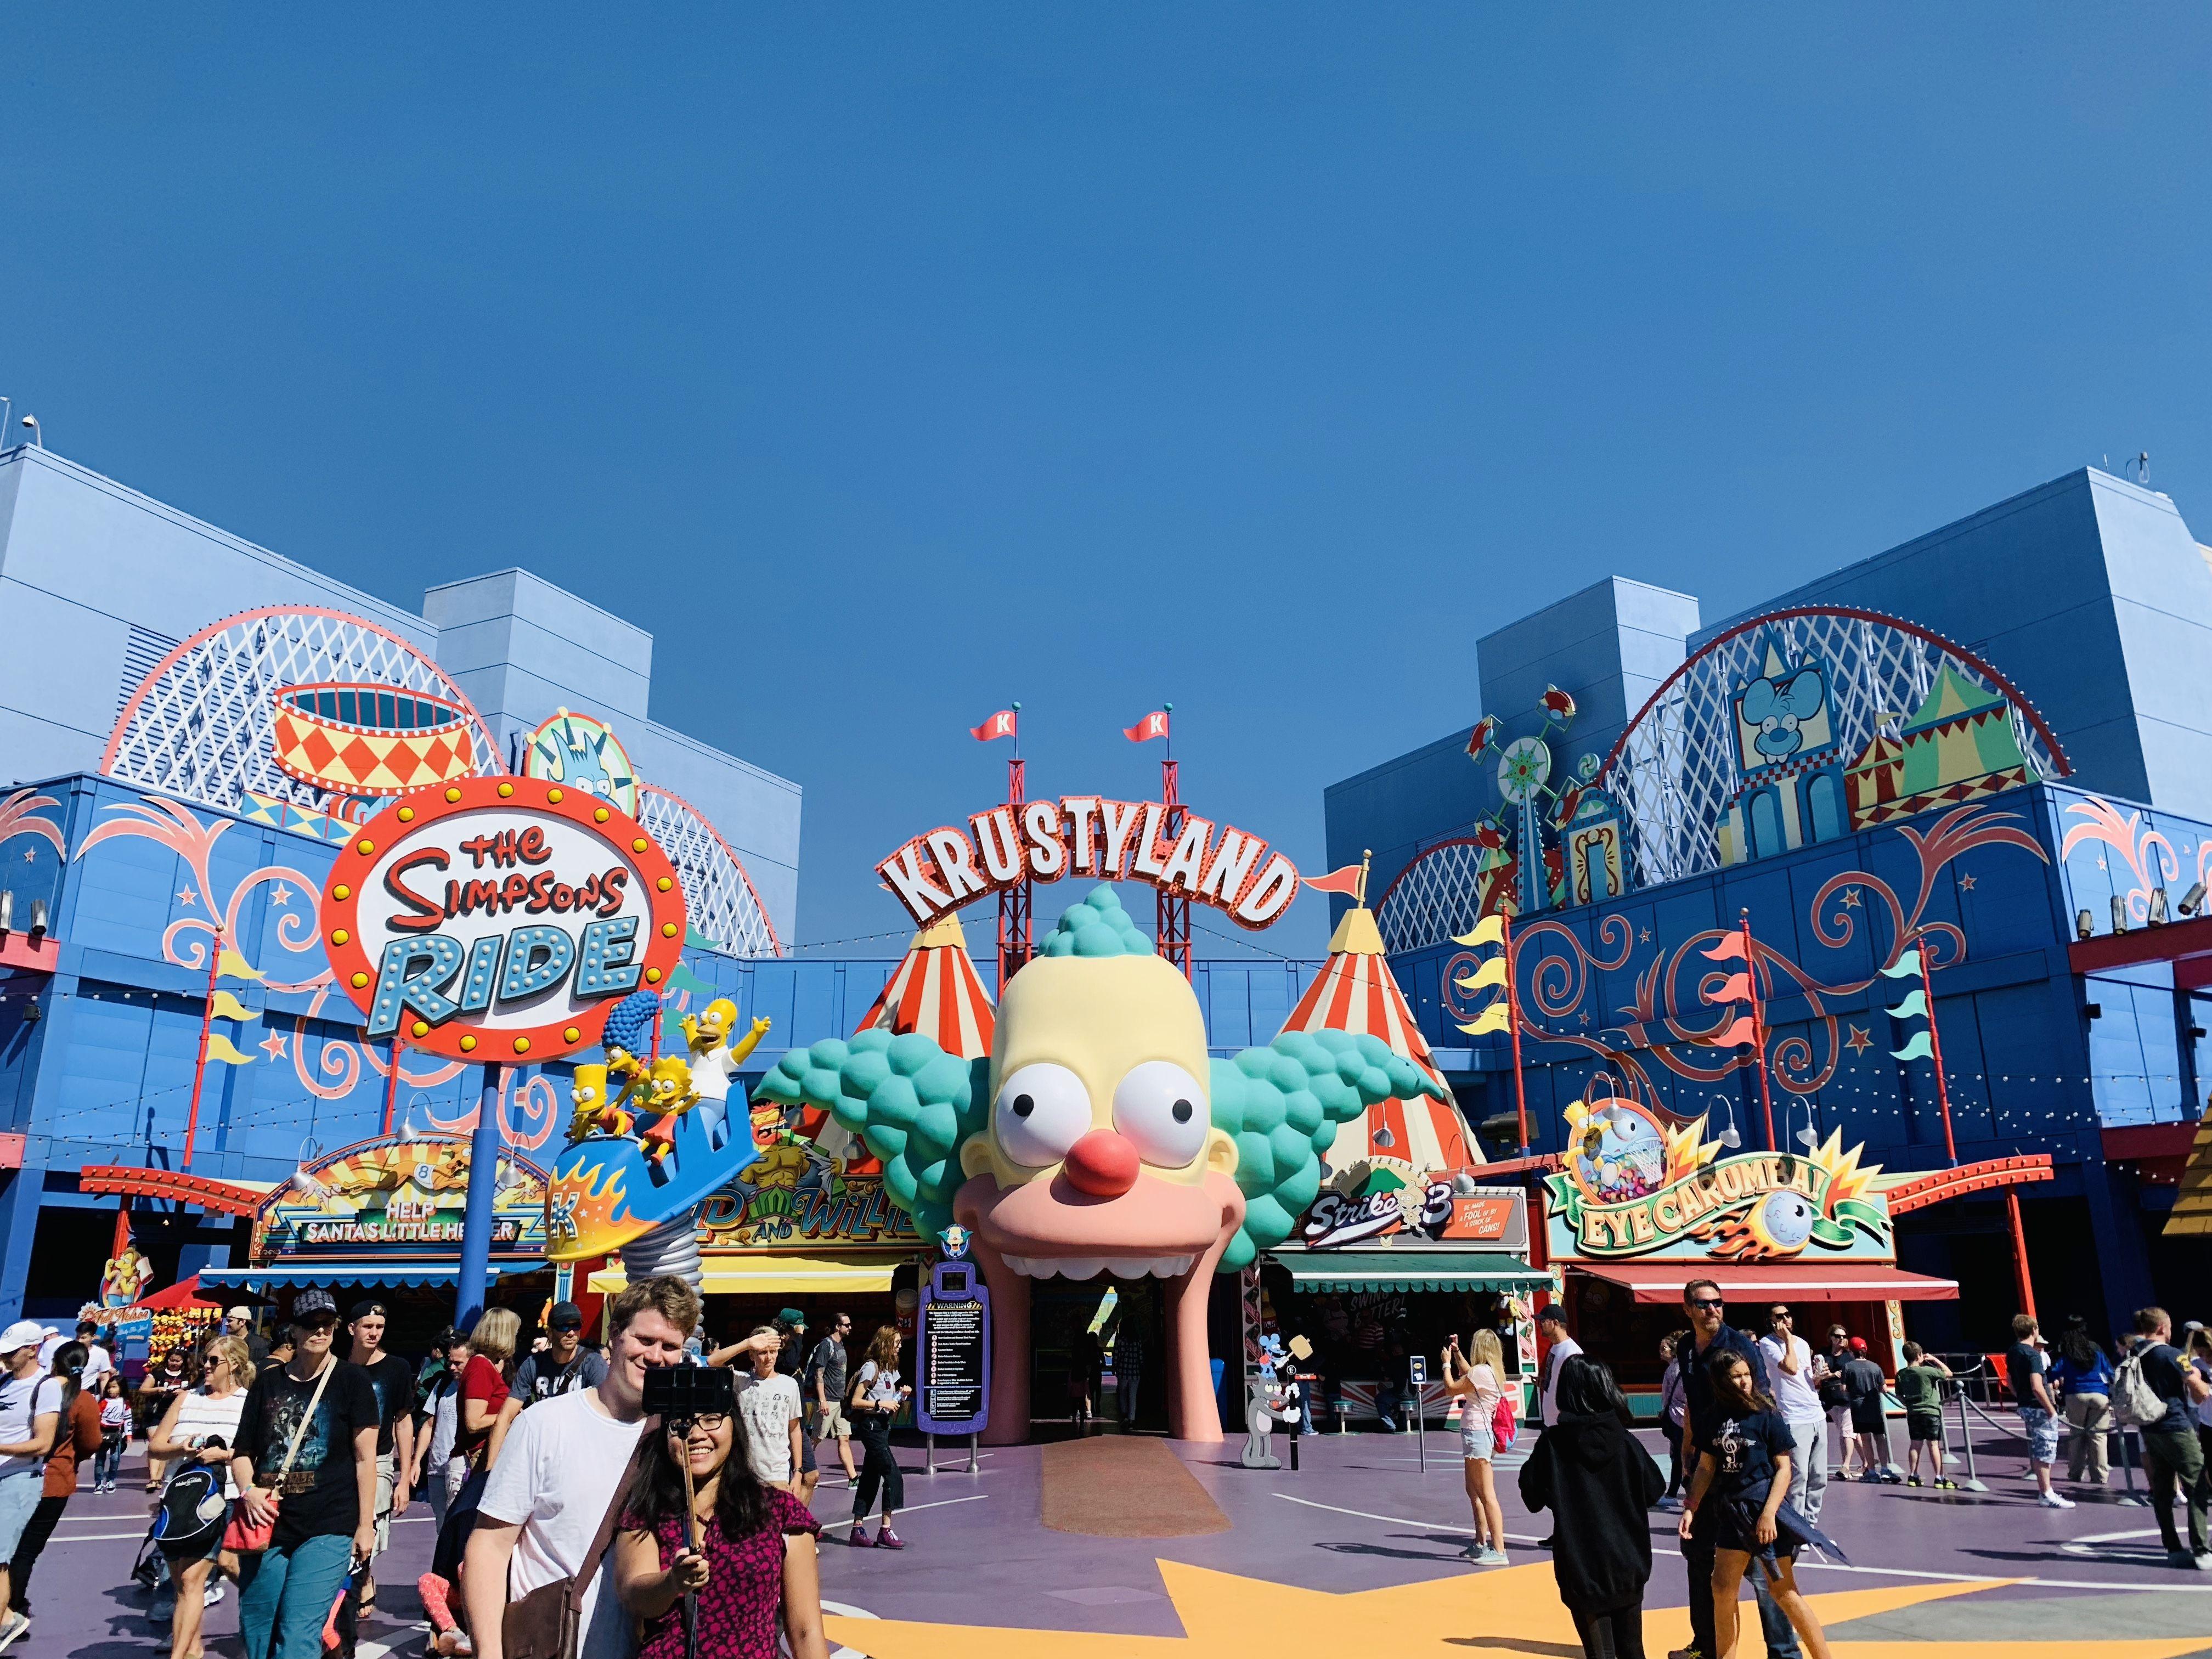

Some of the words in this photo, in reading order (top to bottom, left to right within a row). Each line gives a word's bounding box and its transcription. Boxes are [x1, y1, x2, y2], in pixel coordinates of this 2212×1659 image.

[996, 713, 1012, 733] K
[1150, 714, 1164, 734] K
[874, 795, 1300, 932] KRUSTYLAND
[367, 916, 644, 1040] RIDE
[419, 1166, 428, 1178] 8
[386, 1201, 437, 1222] HELP
[1305, 1191, 1400, 1235] Strike
[1422, 1183, 1453, 1225] 3
[1471, 1200, 1486, 1209] MADE
[1582, 1202, 1656, 1247] EYE
[1652, 1158, 1825, 1233] CARUMBA!
[550, 1191, 580, 1239] K
[1464, 1210, 1481, 1221] FOOL
[1469, 1218, 1485, 1227] STACK
[306, 1222, 381, 1242] SANTA'S
[384, 1223, 443, 1242] LITTLE
[445, 1222, 517, 1242] HEER
[752, 1218, 793, 1242] AND
[1479, 1222, 1500, 1234] CANS!
